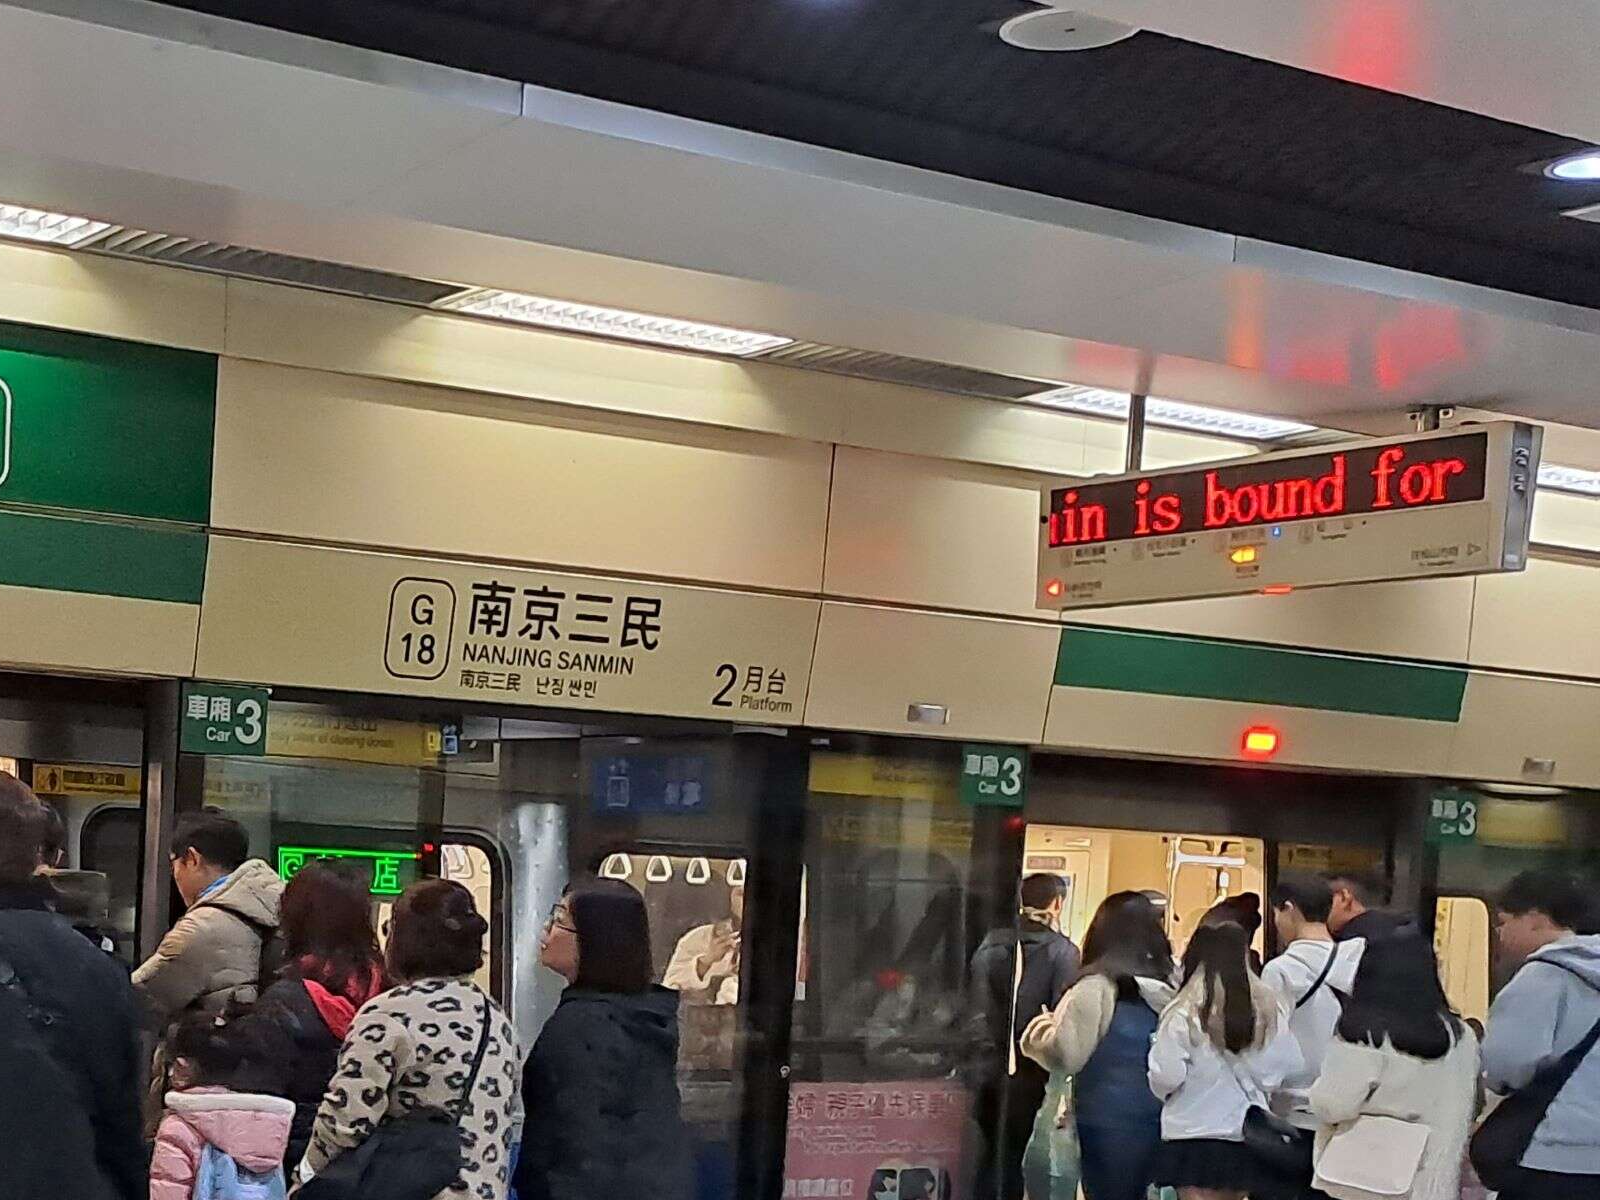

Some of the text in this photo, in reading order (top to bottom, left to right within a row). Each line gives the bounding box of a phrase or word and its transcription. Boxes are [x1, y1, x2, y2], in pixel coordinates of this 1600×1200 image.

[1134, 480, 1182, 535] is
[1204, 455, 1346, 528] bound
[1371, 448, 1465, 508] for
[411, 594, 434, 625] G
[468, 581, 661, 650] 南京三民
[401, 633, 435, 664] 18
[463, 643, 634, 675] NANJING SANMIN
[459, 670, 521, 691] 南京三民
[536, 676, 597, 699] 난징 싼민
[711, 663, 786, 707] 2 月台
[186, 694, 231, 723] 車廂
[234, 699, 262, 745] 3
[740, 695, 792, 713] Platform
[206, 726, 231, 742] Car
[1001, 757, 1022, 796] 3
[1458, 801, 1477, 836] 3
